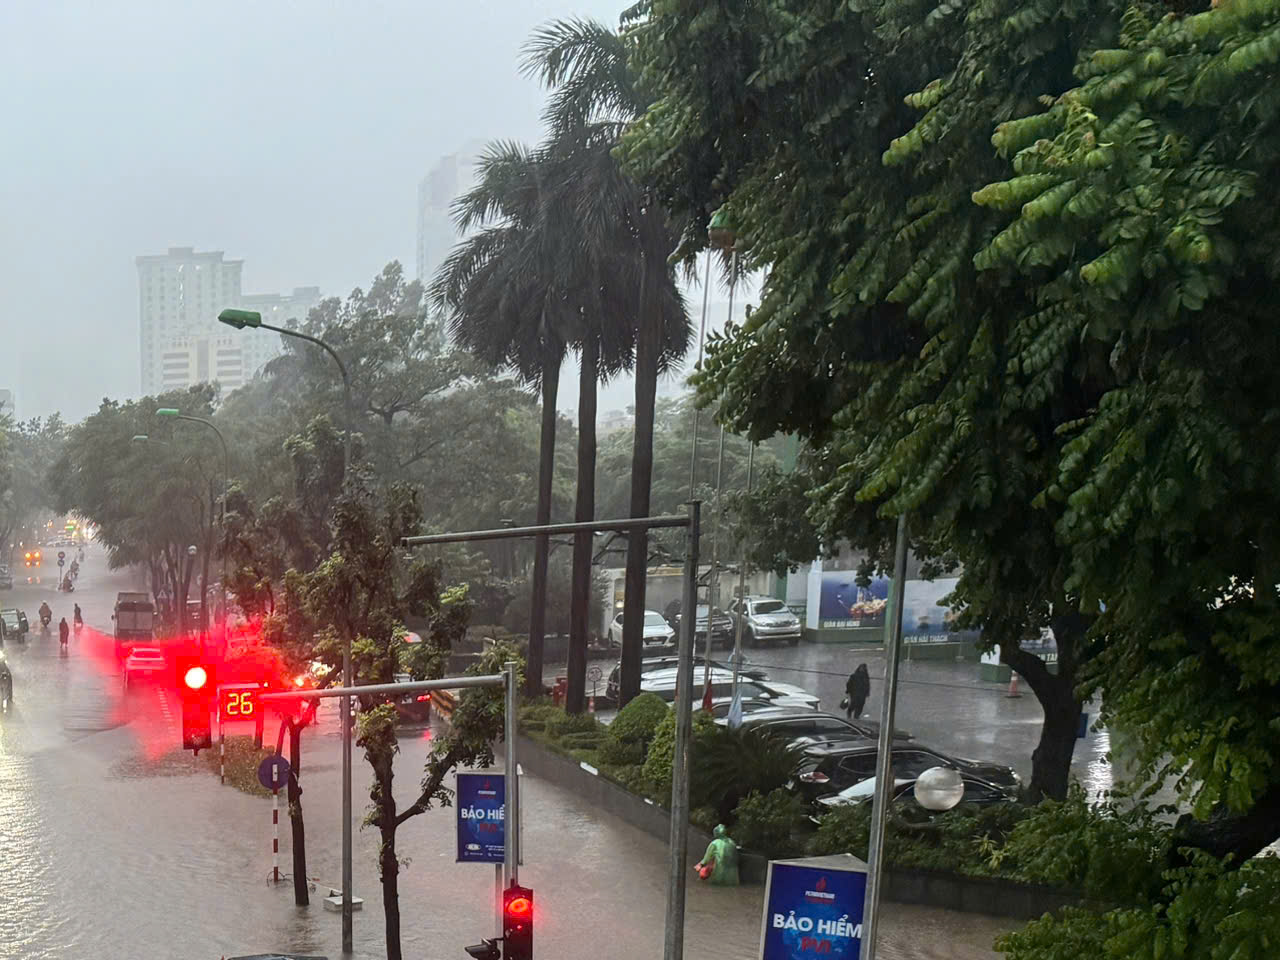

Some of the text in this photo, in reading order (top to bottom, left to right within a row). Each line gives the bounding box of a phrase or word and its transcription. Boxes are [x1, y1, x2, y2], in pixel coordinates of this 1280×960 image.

[226, 692, 254, 715] 26
[461, 804, 505, 820] BẢO HIỂ
[773, 911, 862, 938] BẢO HIỂM
